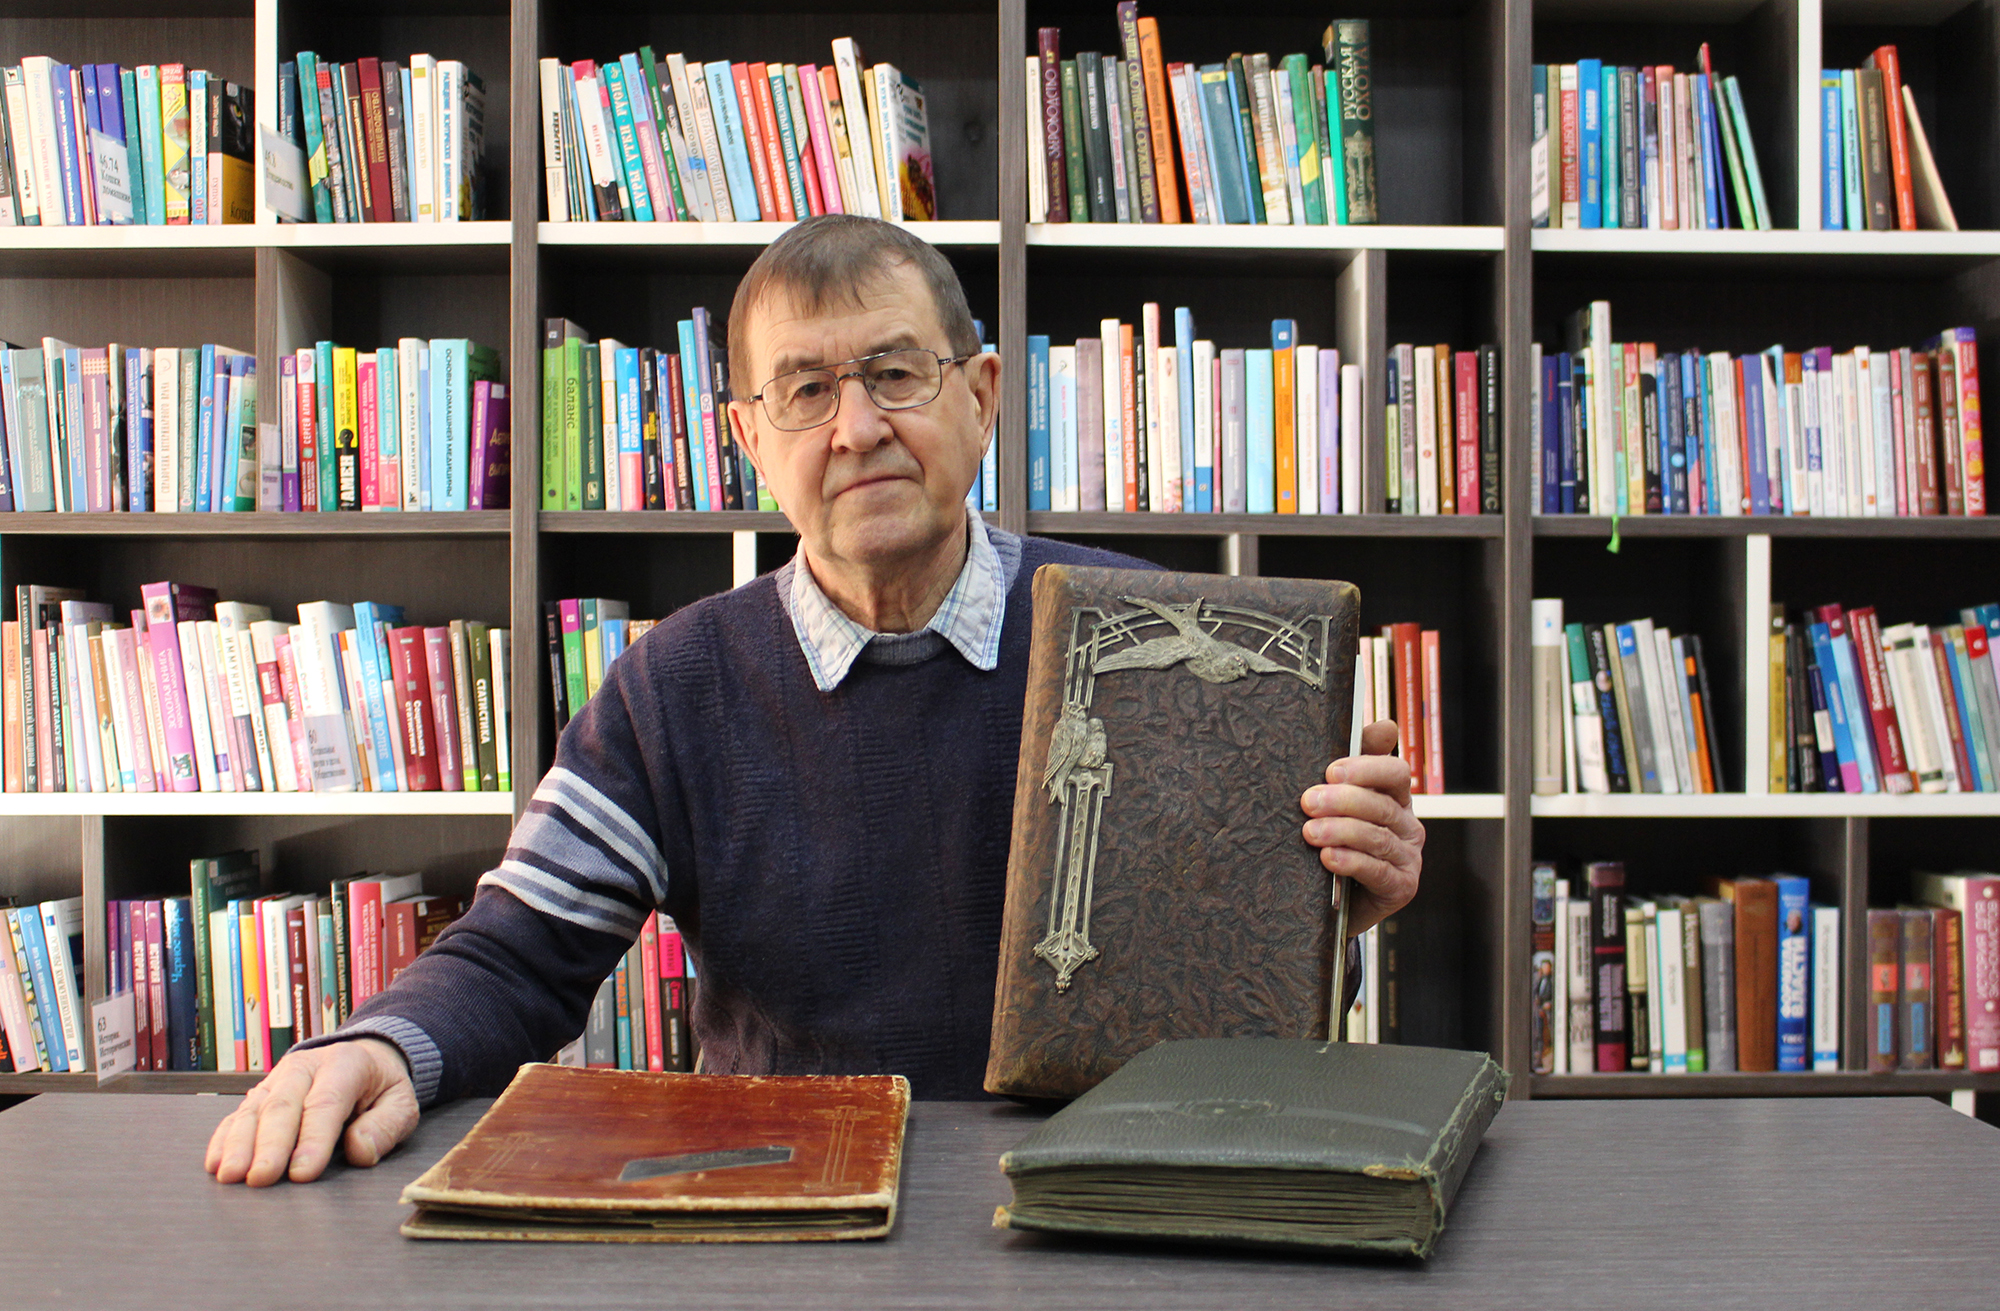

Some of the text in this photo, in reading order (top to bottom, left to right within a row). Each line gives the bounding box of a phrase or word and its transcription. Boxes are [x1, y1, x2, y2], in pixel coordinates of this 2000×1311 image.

[1123, 20, 1138, 61] ЛУЧШЕЕ
[32, 72, 46, 134] Ваша собака
[1127, 61, 1146, 129] ОХОТНИЧЬЕ
[1339, 46, 1357, 120] РУССКАЯ
[1352, 45, 1371, 120] ОХОТА
[57, 99, 66, 123] собак
[370, 91, 386, 162] ПТИЦЕВОДСТВО
[1042, 68, 1063, 158] ЗВЕРОВОДСТВО
[39, 137, 50, 182] ВОСПИТАНИЕ
[417, 112, 427, 168] ПТИЦЕВОДСТВО
[610, 80, 649, 209] КУРЫ УТКИ ГУСИ
[638, 125, 655, 164] ДОМАШНЕМУ
[678, 101, 706, 180] ПЧЕЛОВОДСТВО
[738, 79, 773, 212] КАК ПОВЫСИТЬ ДОХОДНОСТЬ ПАСЕКИ
[771, 78, 806, 217] НАСТОЛЬНАЯ КНИГА ПЧЕЛОВОДА
[805, 72, 837, 208] СОВРЕМЕННЫЙ СПРАВОЧНИК ПЧЕЛОВОДА
[1135, 129, 1151, 177] ОРУЖИЕ
[1560, 92, 1577, 200] КНИГА РЫБОЛОВА
[194, 160, 204, 220] 500 СОВЕТОВ
[646, 164, 656, 174] ПО
[648, 173, 664, 212] СПРАВОЧНИК
[767, 141, 790, 214] ПЧЕЛОВОДСТВО
[1140, 177, 1154, 207] МИРА
[44, 189, 53, 210] УХОД
[183, 361, 192, 401] ТЕРАПЕВТА
[383, 369, 392, 411] СПАСАЮТ
[564, 376, 578, 429] баланс
[604, 382, 614, 421] СИСТЕМА
[628, 377, 637, 410] СОСУДОВ
[687, 385, 697, 408] офис
[1029, 387, 1037, 430] Здоровый
[1401, 379, 1413, 406] КАК
[160, 381, 170, 493] СПРАВОЧНИК ВЕТЕРИНАРНОГО ВРАЧА
[202, 411, 210, 452] Справочник
[301, 384, 312, 444] СЕРГЕЙ АГАПКИН
[445, 387, 453, 442] ДОМАШНЕЙ
[620, 392, 630, 448] КОД ЗДОРОВЬЯ
[630, 418, 639, 448] СЕРДЦА
[691, 420, 699, 445] риска
[1122, 355, 1135, 483] ГИМНАСТИКА ПРОТИВ СТАРЕНИЯ
[337, 454, 356, 501] АМЕН
[675, 437, 686, 486] БУБНОВСКИЙ
[701, 417, 720, 486] БУБНОВСКИЙ
[180, 457, 191, 506] СПРАВОЧНИК
[1485, 452, 1497, 509] ВИРУС
[1966, 478, 1983, 511] КАК
[47, 650, 62, 747] ИММУНИТЕТ АТАКУЕТ
[155, 649, 178, 730] ЗОЛОТАЯ КНИГА
[164, 647, 185, 728] народной медицины
[223, 635, 246, 709] ИММУНИТЕТ
[7, 679, 17, 722] ПОСТКОВИД
[363, 659, 390, 759] НА ОДНОЙ ВОЛНЕ
[404, 700, 417, 754] статистика
[412, 699, 427, 757] Социальная
[473, 678, 494, 744] СТАТИСТИКА
[133, 941, 144, 980] ИСТОРИЯ
[149, 943, 160, 982] ИСТОРИЯ
[167, 908, 187, 982] Черное море
[1974, 899, 1989, 1000] ИСТОРИЯ ДЛЯ
[1986, 898, 2000, 999] ЭКОНОМИСТОВ
[615, 970, 627, 1017] ИСТОРИЯ
[1778, 937, 1793, 1018] ФОРМУЛА
[1788, 936, 1808, 1018] ВЛАСТИ
[97, 1017, 107, 1032] 63
[140, 1057, 146, 1066] 1
[157, 1059, 163, 1068] 2
